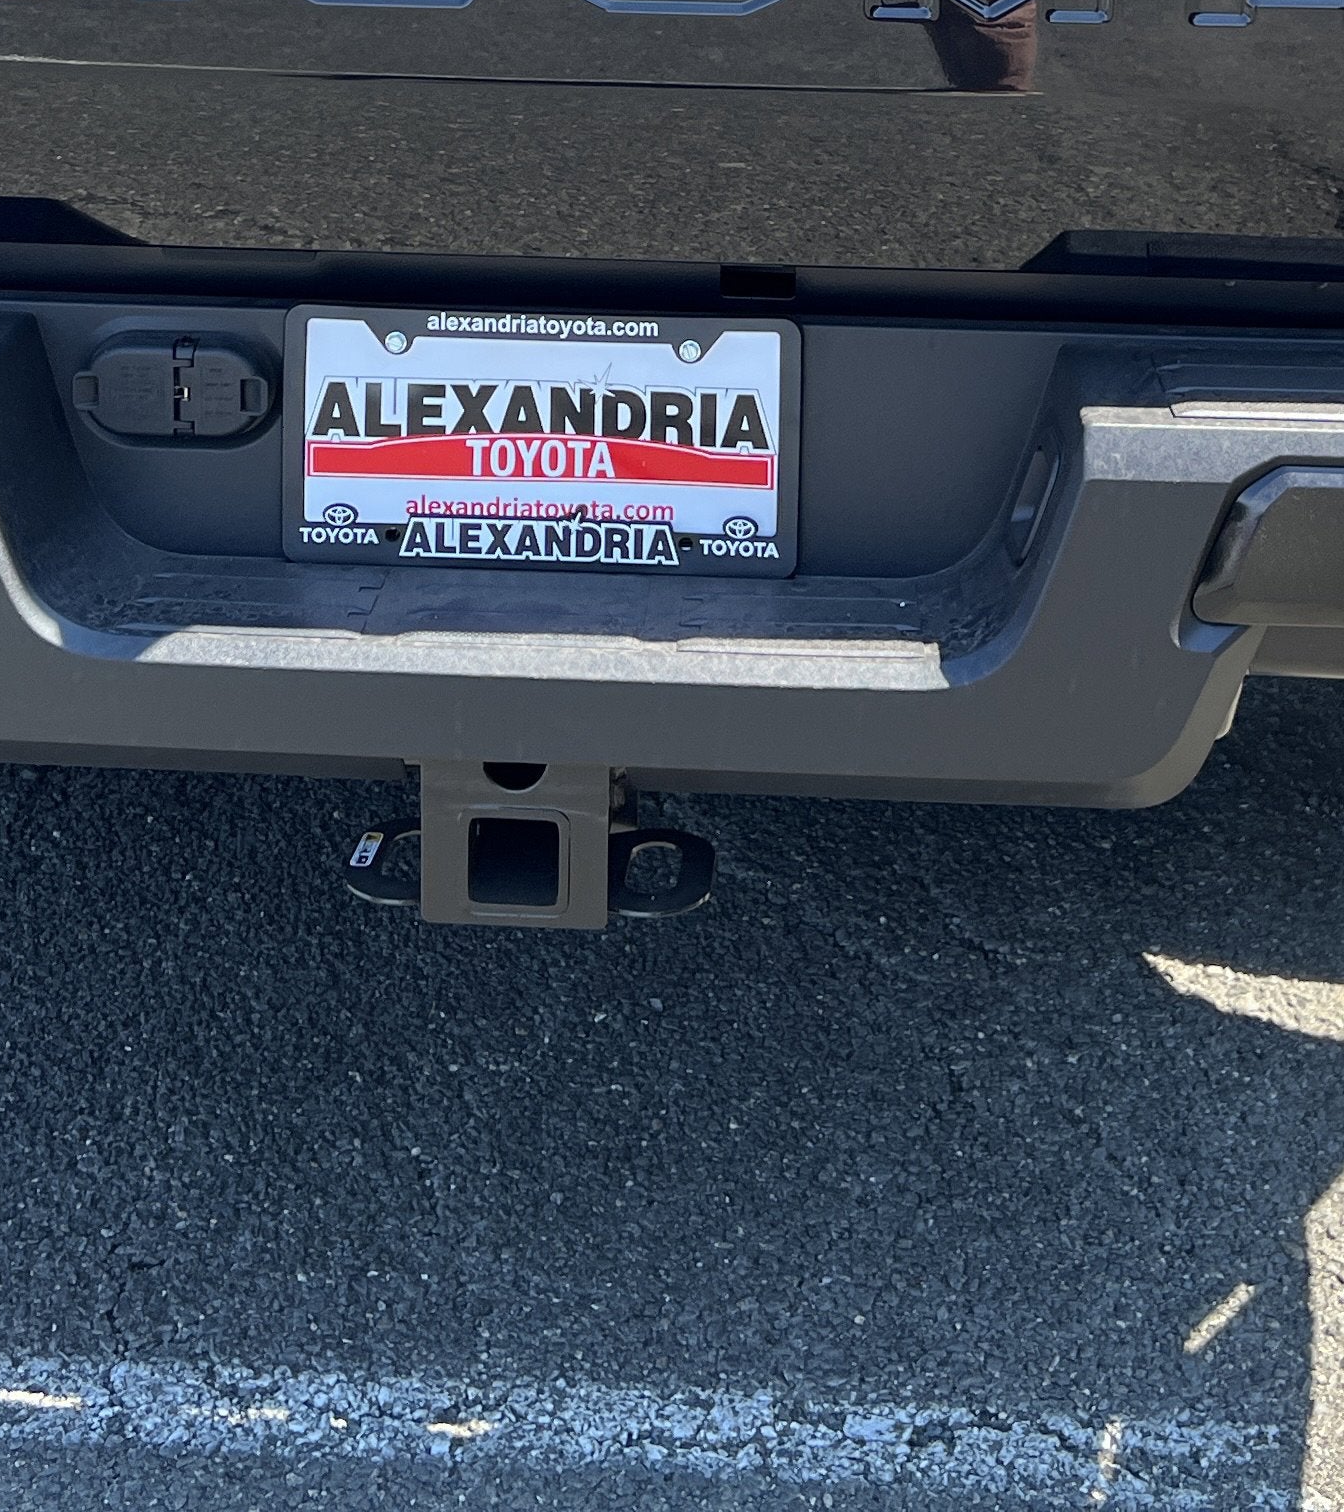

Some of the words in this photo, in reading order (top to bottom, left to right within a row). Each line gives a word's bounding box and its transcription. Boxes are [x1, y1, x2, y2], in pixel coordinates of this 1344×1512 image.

[426, 311, 659, 337] alexandriatoyota.com
[312, 378, 770, 451] ALEXANDRIA
[466, 438, 616, 478] TOYOTA
[299, 527, 379, 546] TOYOTA
[400, 518, 678, 564] ALEXANDRIA
[699, 539, 779, 559] TOYOTA
